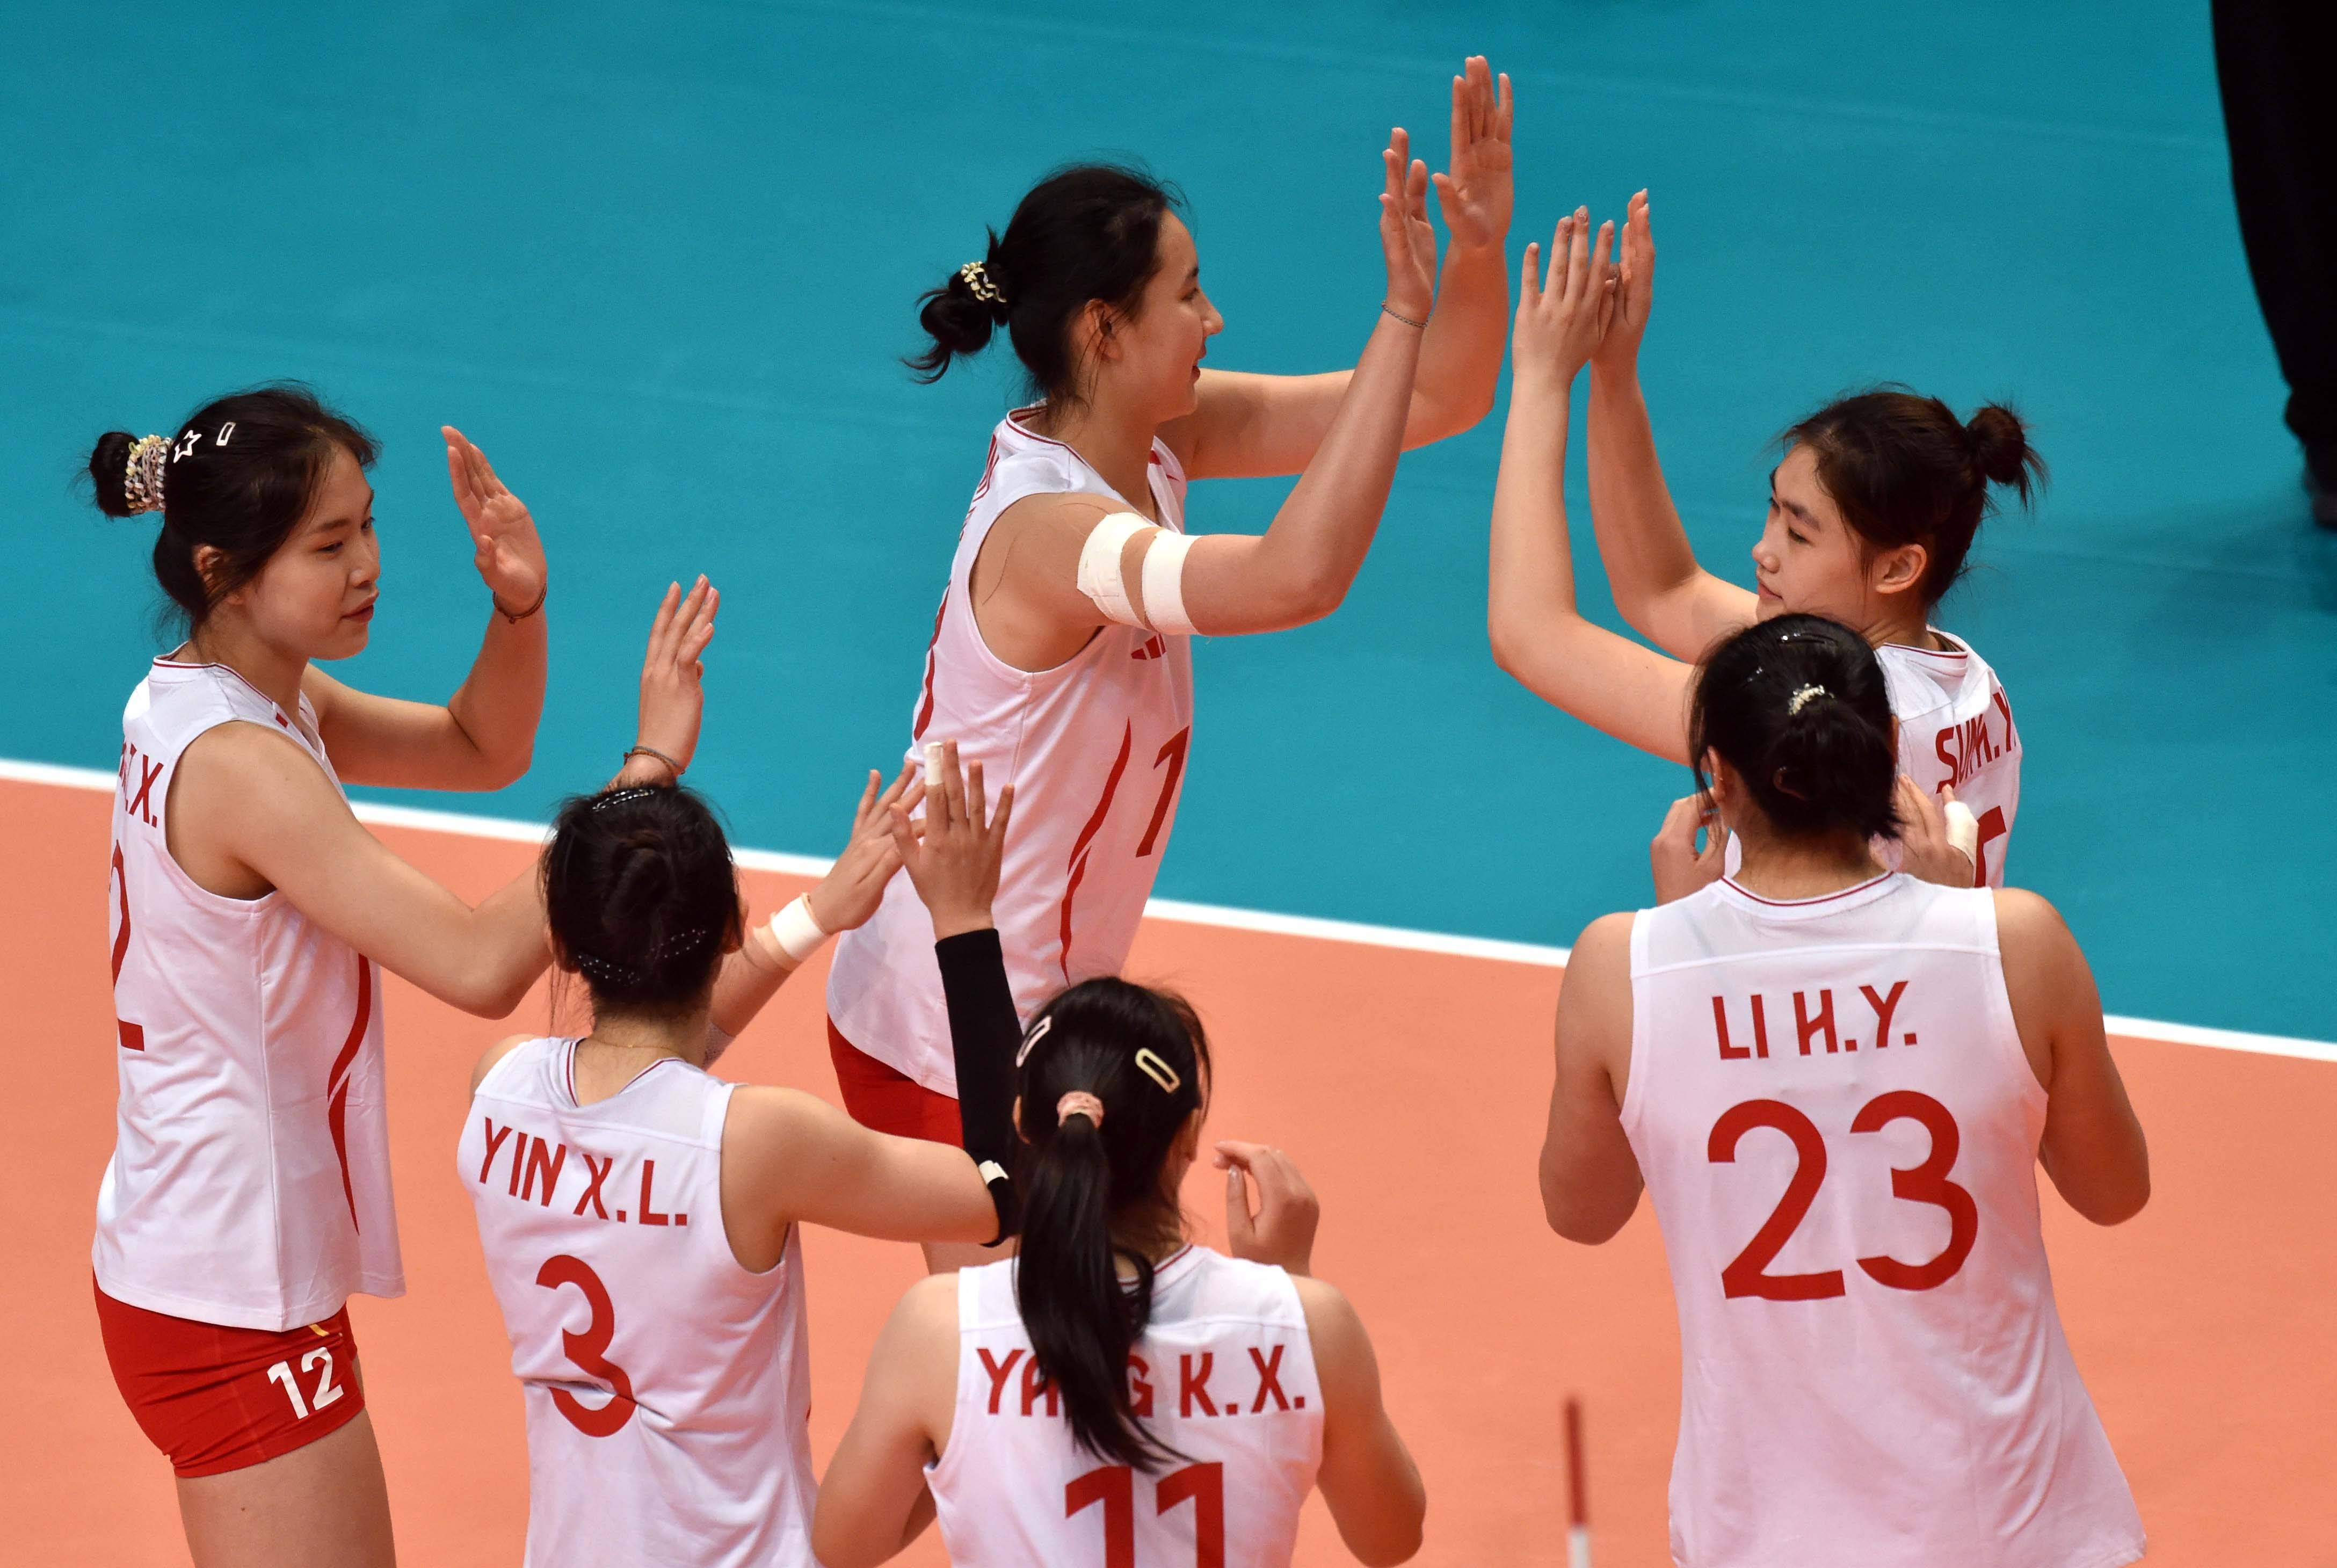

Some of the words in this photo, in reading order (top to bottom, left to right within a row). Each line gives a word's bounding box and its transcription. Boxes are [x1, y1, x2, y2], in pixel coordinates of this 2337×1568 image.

[1712, 994, 1769, 1060] LI
[1793, 981, 1917, 1056] H.Y.
[479, 1117, 567, 1207] YIN
[574, 1153, 687, 1226] X.L.
[1707, 1090, 1979, 1302] 23
[266, 1346, 344, 1419] 12
[535, 1254, 638, 1438] 3
[977, 1348, 1154, 1418] YAG
[1180, 1344, 1305, 1418] K.X.
[1065, 1461, 1225, 1568] 11
